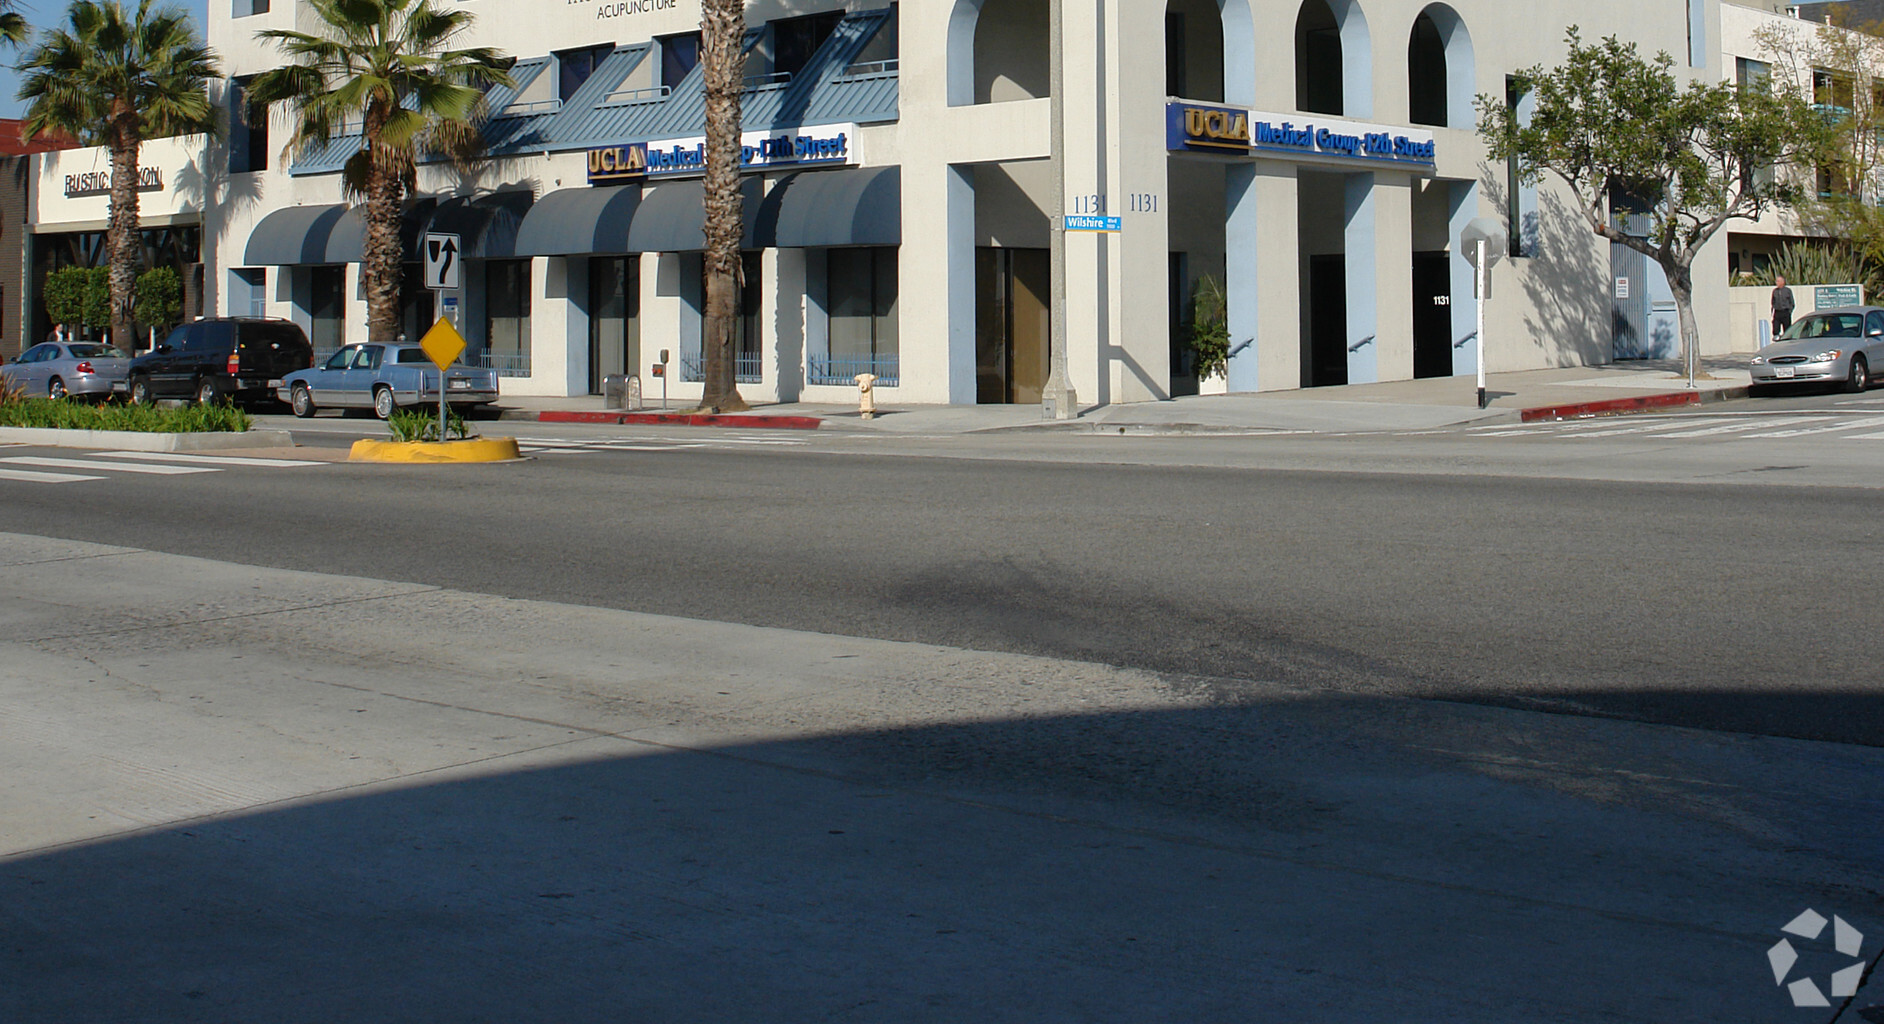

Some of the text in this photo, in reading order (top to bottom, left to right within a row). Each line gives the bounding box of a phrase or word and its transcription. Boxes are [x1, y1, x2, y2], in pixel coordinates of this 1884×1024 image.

[1184, 108, 1250, 141] UCLA
[1255, 121, 1314, 146] Medical
[1394, 136, 1435, 157] Street
[588, 146, 645, 173] UCLA
[647, 143, 704, 166] Medical
[795, 133, 847, 156] Street
[65, 171, 109, 192] RUSTIC
[1075, 195, 1106, 213] 1131
[1131, 193, 1157, 212] 1131
[1067, 217, 1104, 228] Wilshire
[1433, 295, 1449, 305] 1131
